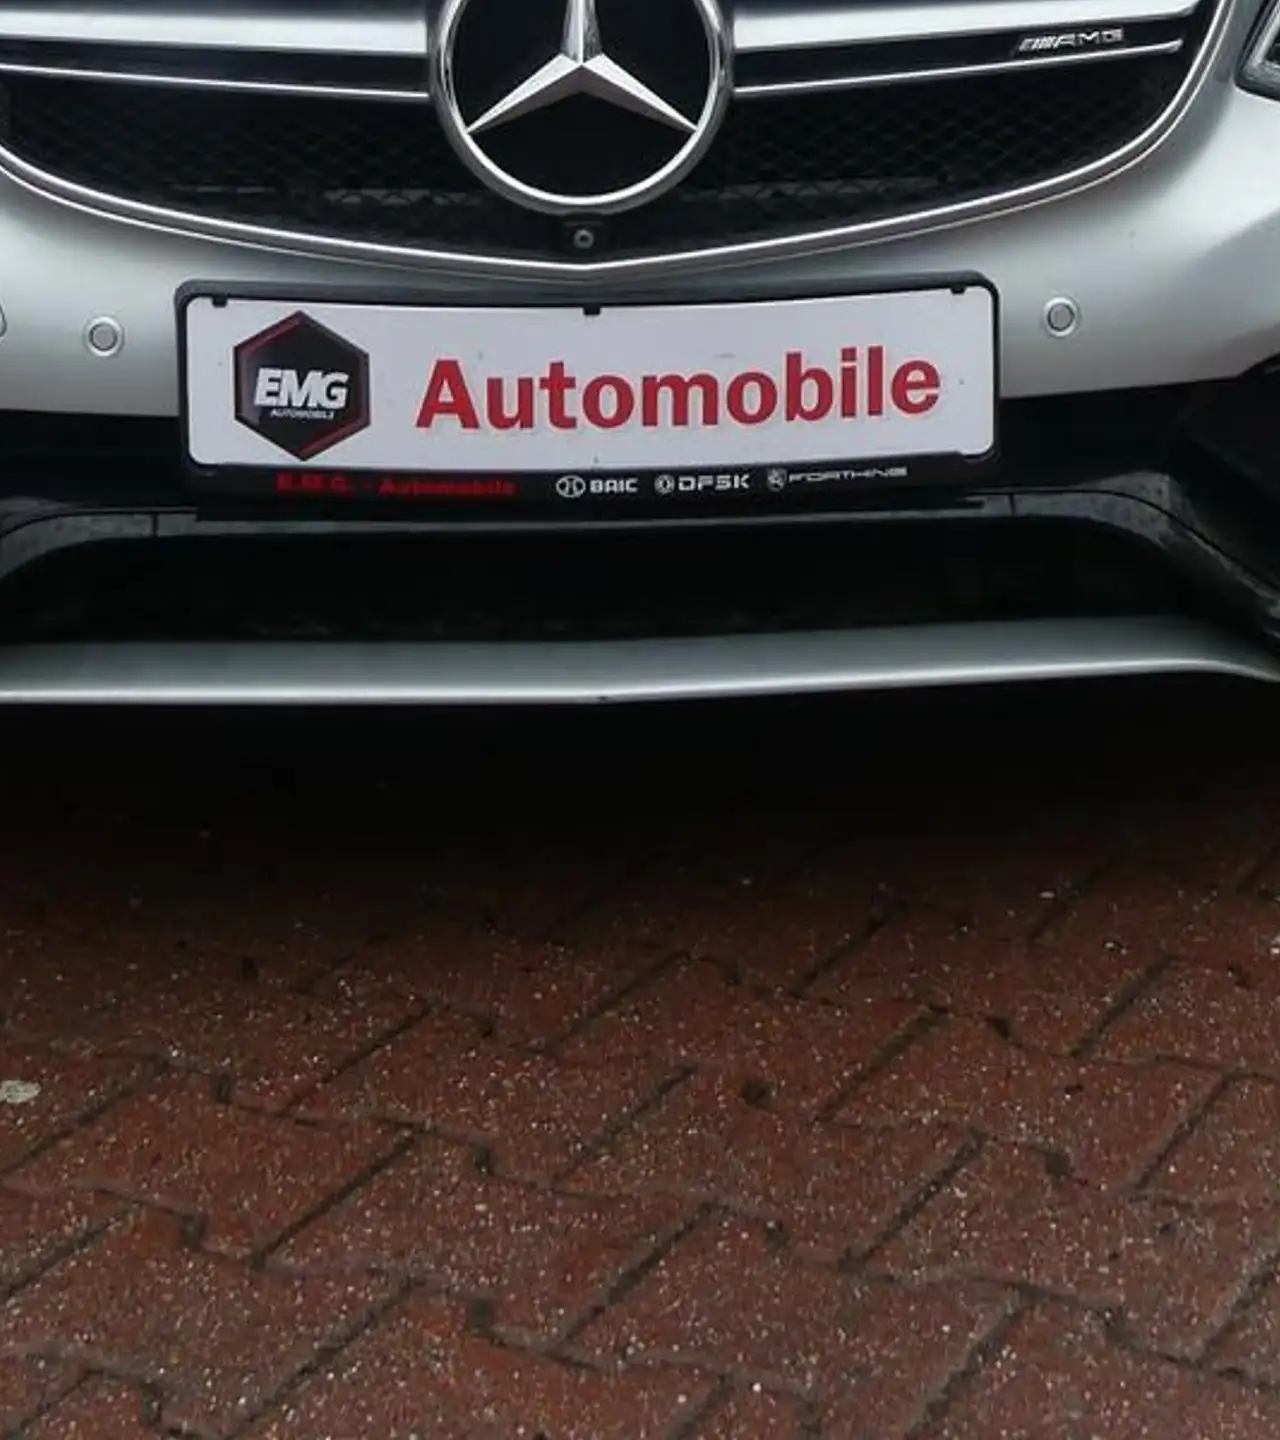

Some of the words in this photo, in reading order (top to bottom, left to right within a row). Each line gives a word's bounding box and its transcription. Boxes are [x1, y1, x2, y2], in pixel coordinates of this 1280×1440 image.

[254, 367, 349, 410] EMG
[415, 344, 941, 431] Automobile
[590, 478, 638, 493] BAIC
[678, 474, 750, 491] DFSK
